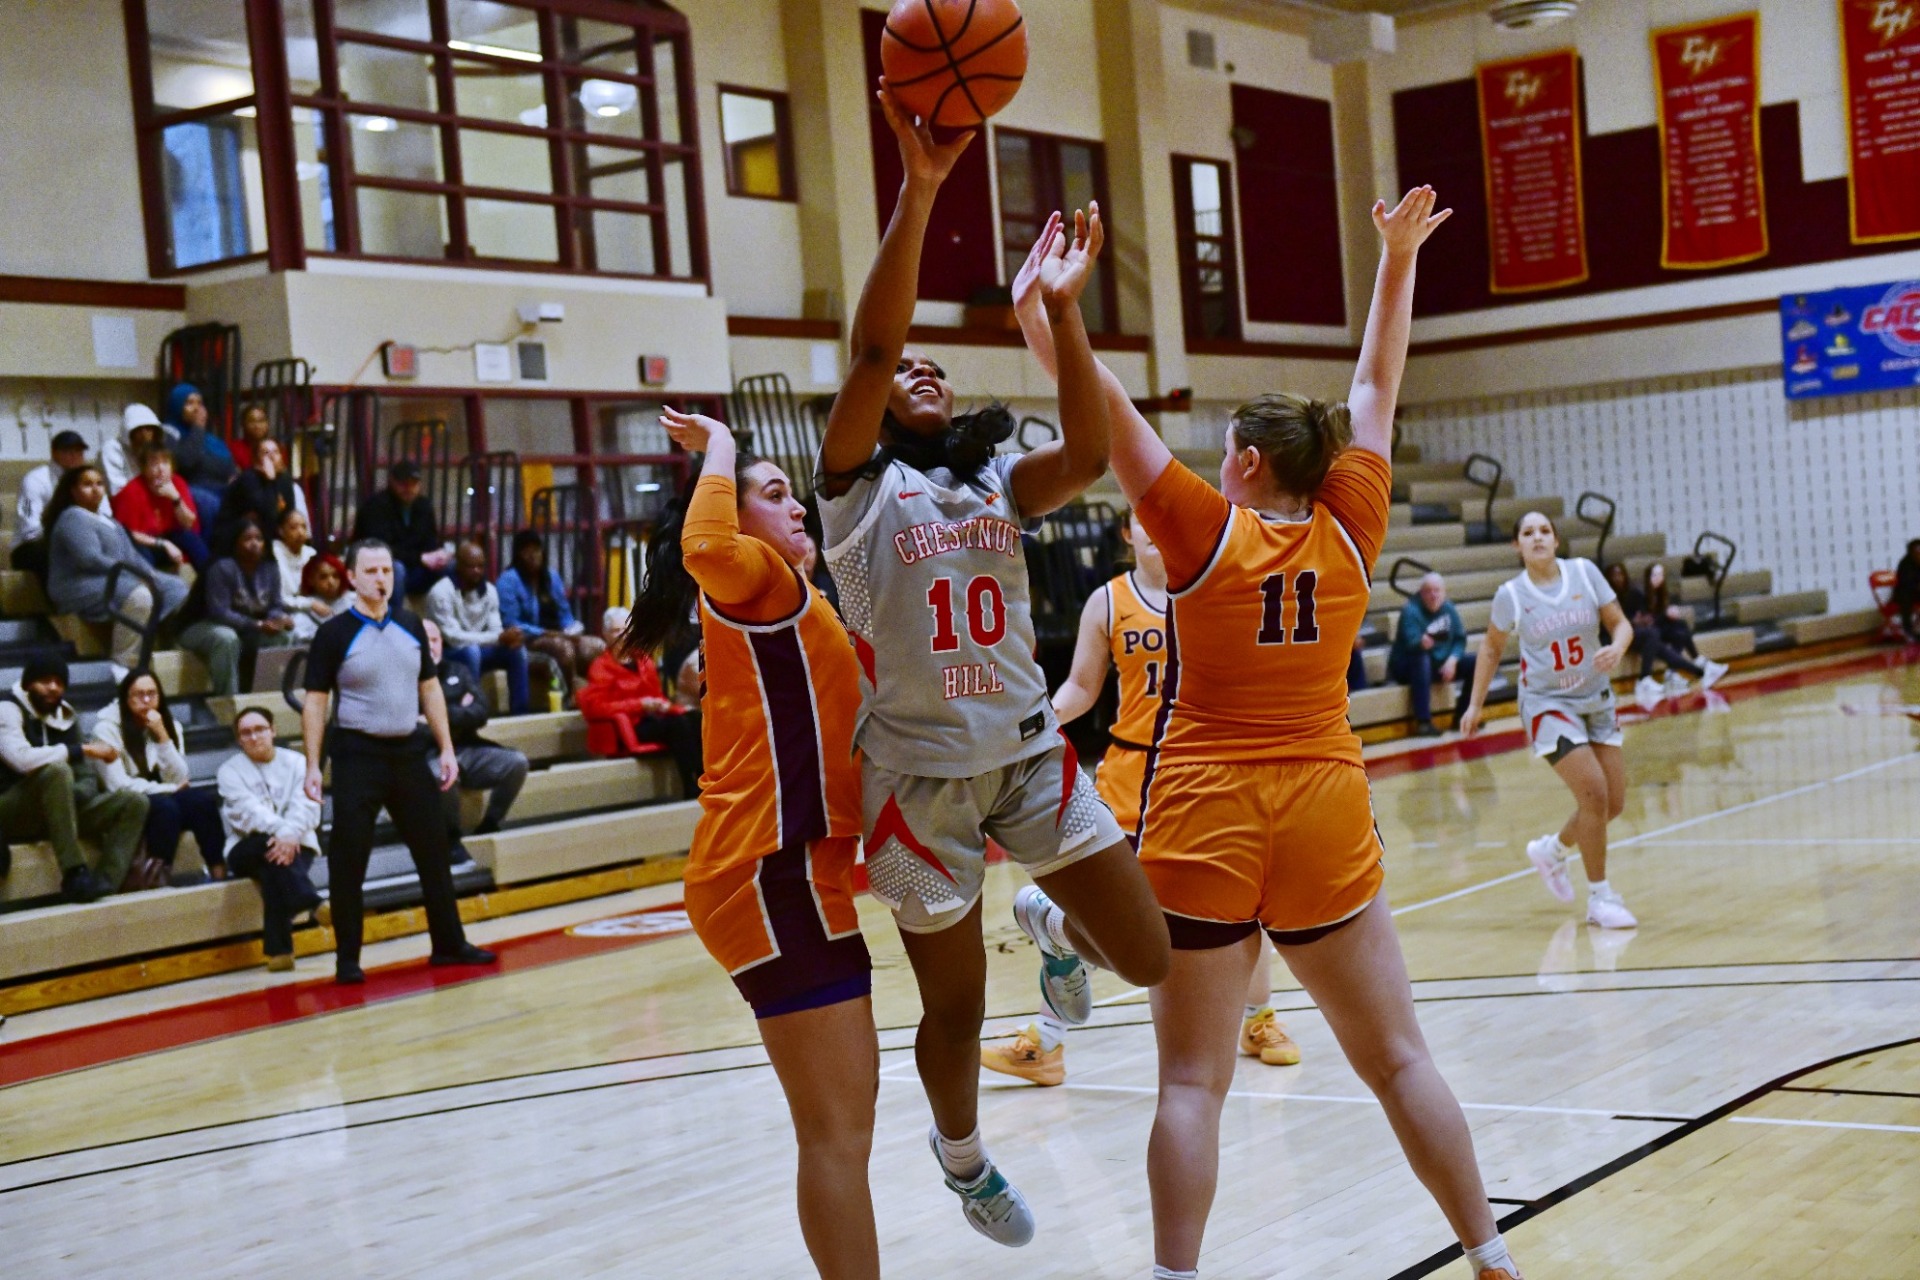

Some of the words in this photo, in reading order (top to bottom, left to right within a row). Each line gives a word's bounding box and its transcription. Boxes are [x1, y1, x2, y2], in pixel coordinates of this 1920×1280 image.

[893, 516, 1021, 566] CHESTNUT
[926, 574, 1008, 654] 10
[1257, 569, 1320, 646] 11
[1550, 636, 1584, 672] 15
[943, 662, 1005, 700] HILL
